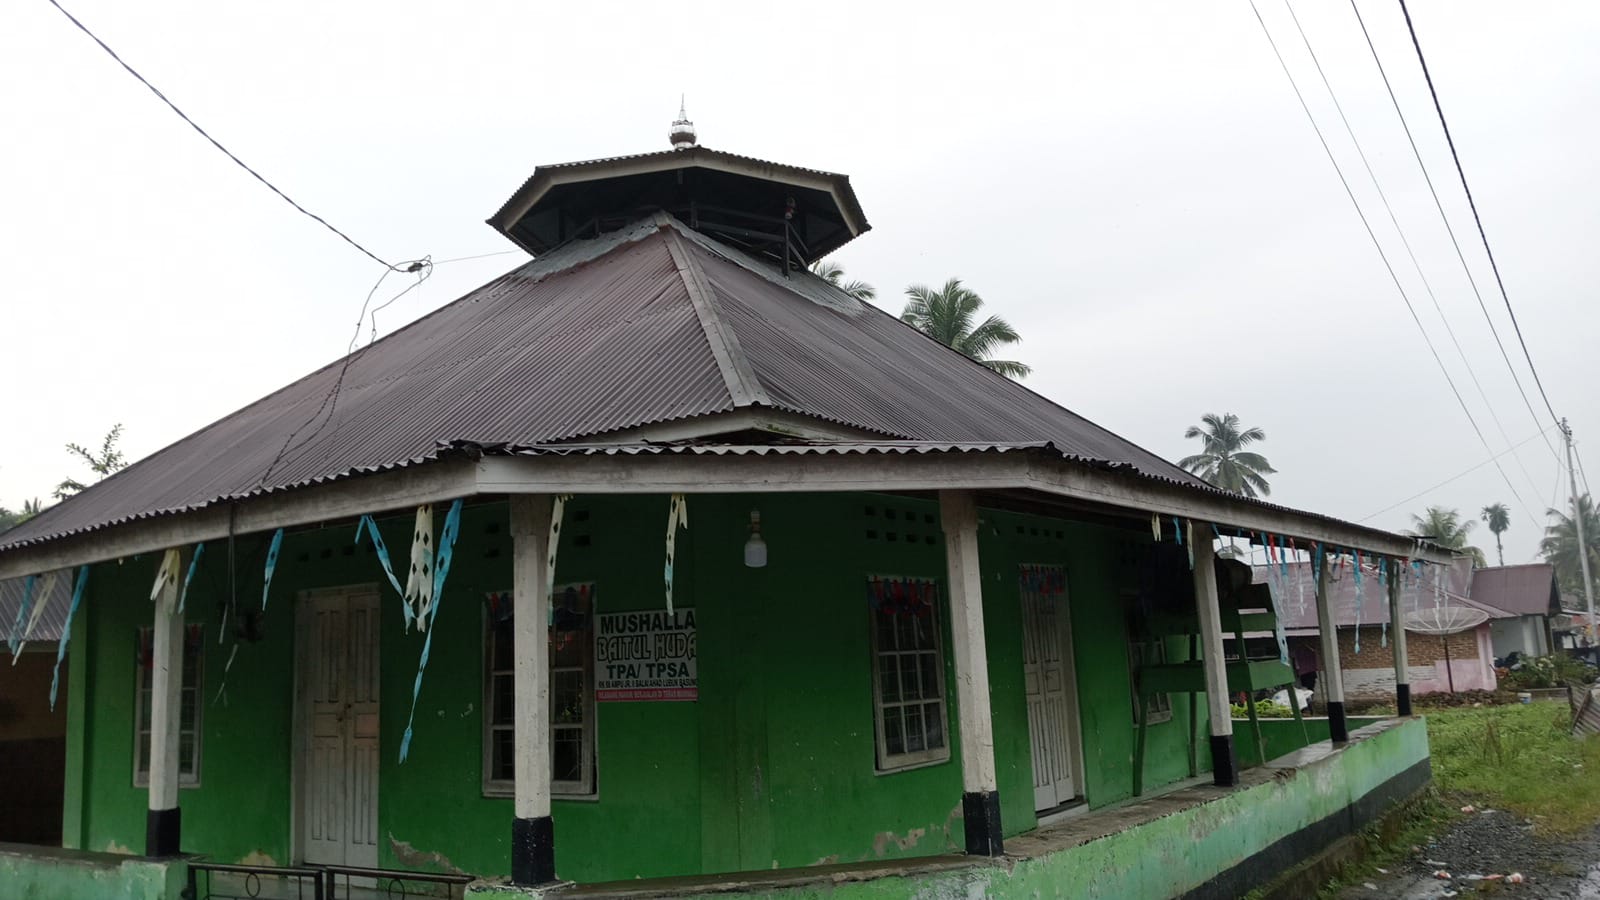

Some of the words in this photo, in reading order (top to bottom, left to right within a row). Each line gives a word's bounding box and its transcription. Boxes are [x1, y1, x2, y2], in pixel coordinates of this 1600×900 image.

[600, 611, 696, 635] MUSHALLA
[597, 634, 652, 664] BAITUL
[654, 632, 697, 662] HUDA
[606, 664, 641, 680] TPA/
[645, 662, 690, 678] TPSA
